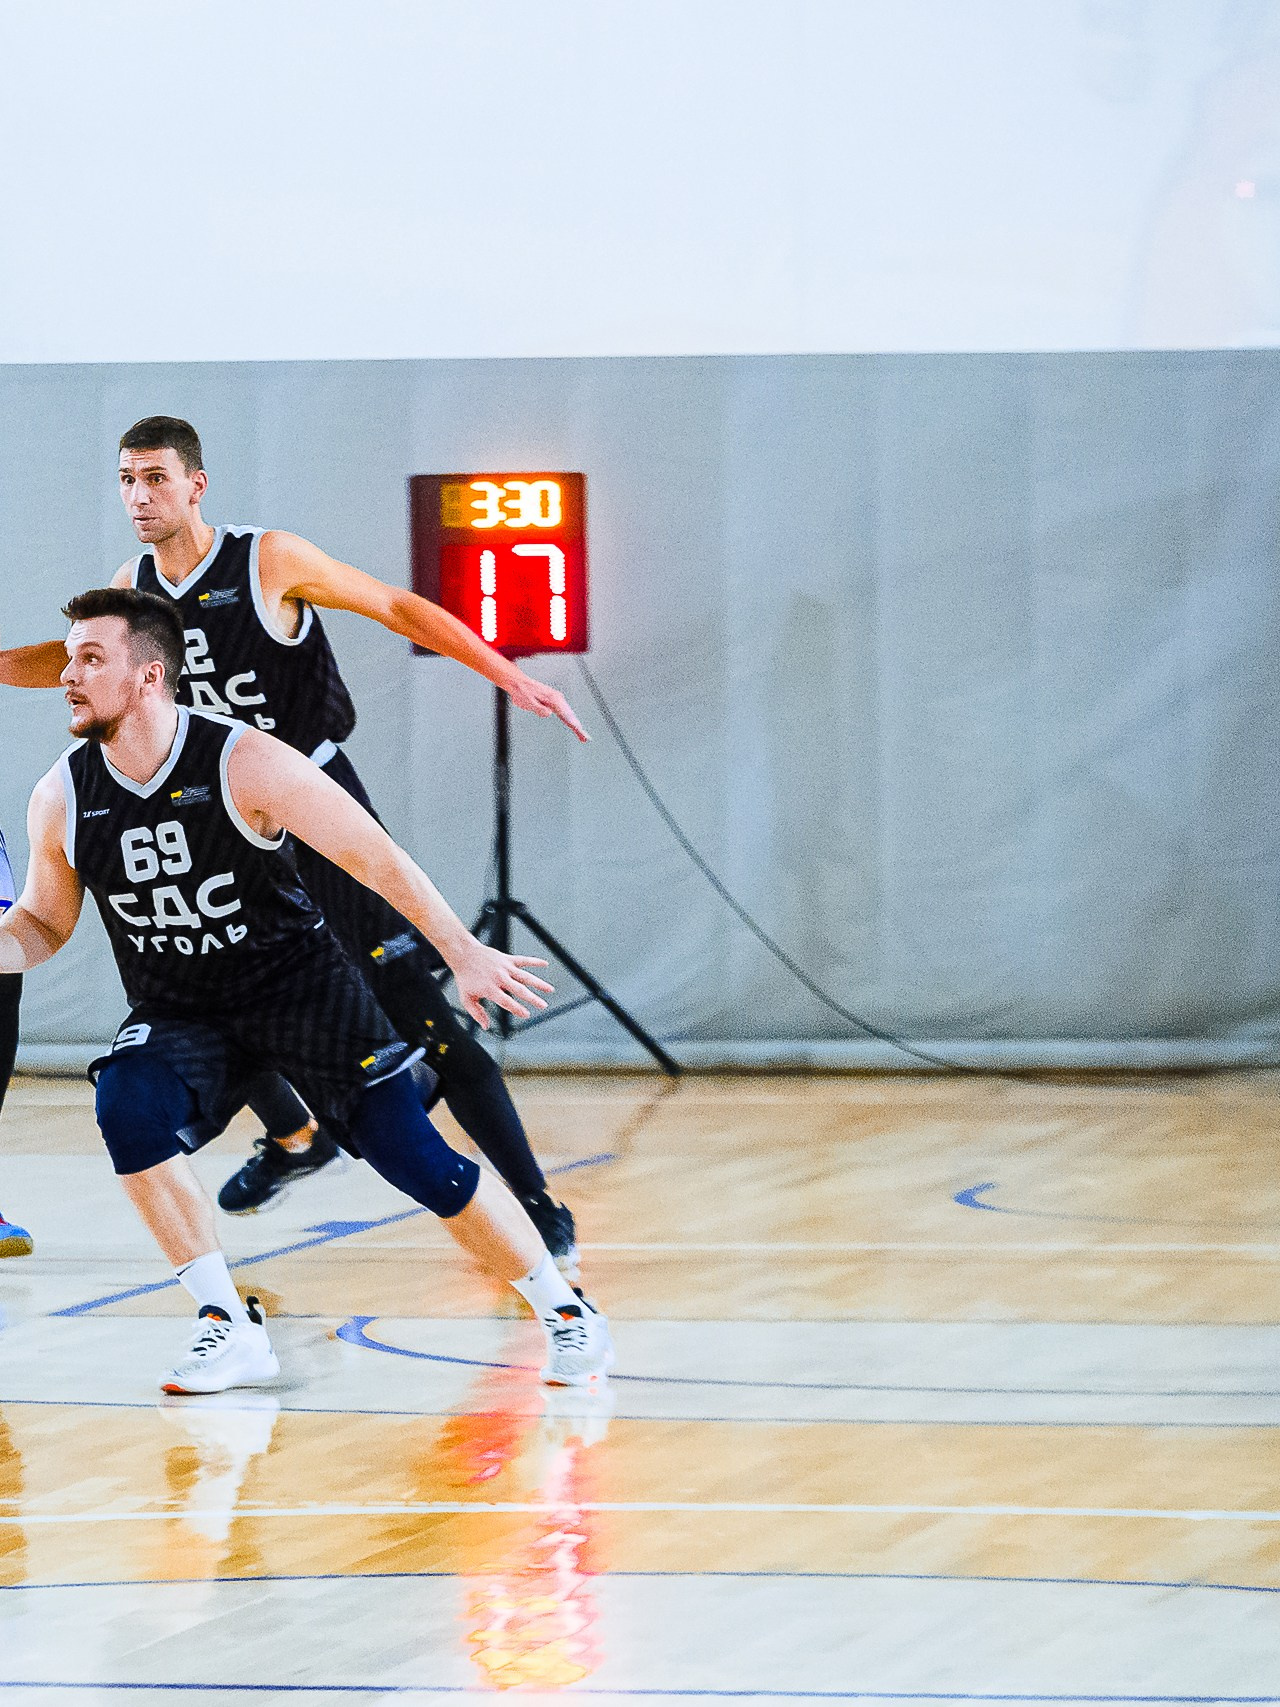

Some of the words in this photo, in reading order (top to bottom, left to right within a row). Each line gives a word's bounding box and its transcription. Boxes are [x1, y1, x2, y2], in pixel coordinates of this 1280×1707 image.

[480, 543, 566, 642] 17
[181, 628, 216, 675] 2
[177, 670, 267, 715] ДС
[120, 820, 192, 883] 69
[108, 871, 242, 929] СДС
[127, 923, 248, 955] УГОЛЬ
